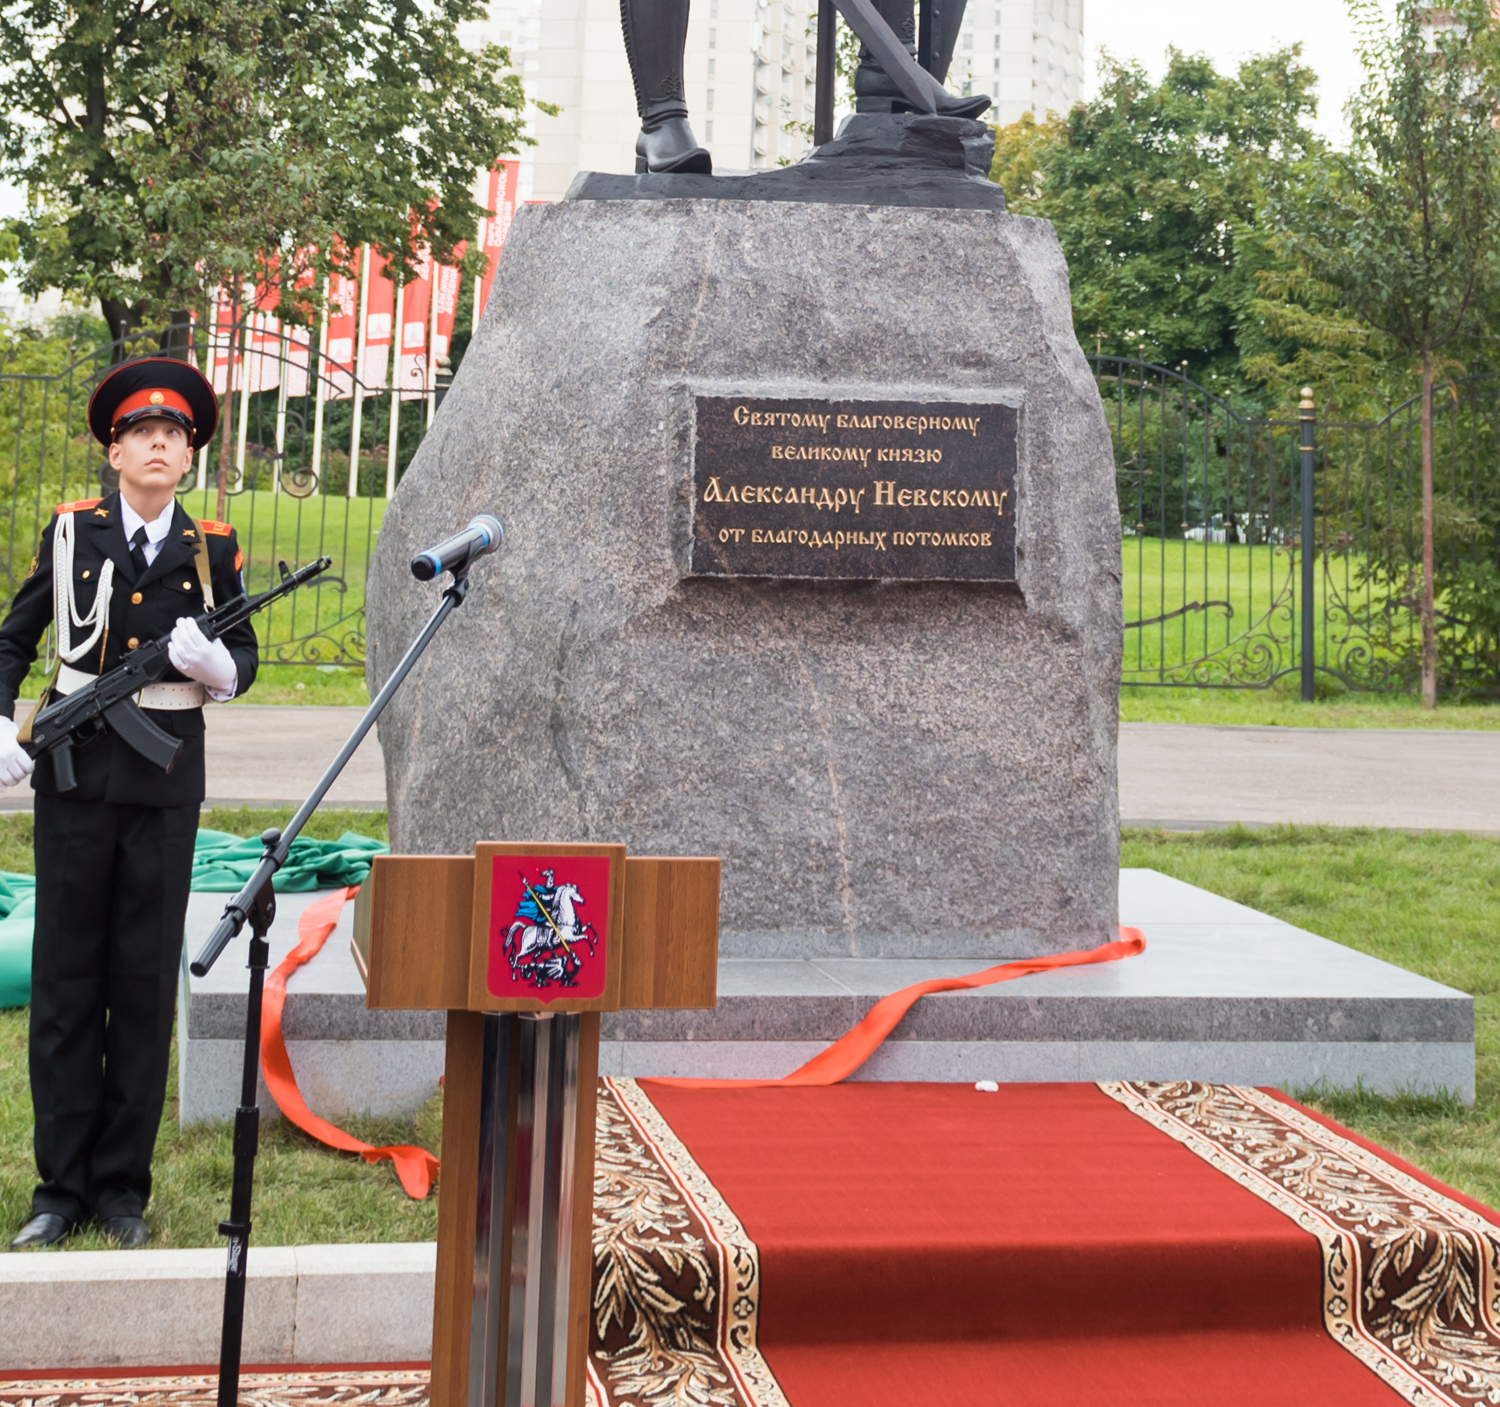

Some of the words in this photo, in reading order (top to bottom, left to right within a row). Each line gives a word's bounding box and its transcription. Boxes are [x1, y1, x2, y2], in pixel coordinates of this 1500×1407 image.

[733, 405, 831, 434] Святому
[836, 414, 981, 437] благоверному
[771, 445, 872, 468] великому
[877, 447, 943, 463] князю
[703, 476, 865, 514] Александру
[873, 480, 1009, 516] Невскому
[718, 528, 746, 543] от
[751, 528, 887, 551] благодарных
[892, 531, 993, 547] потомков
